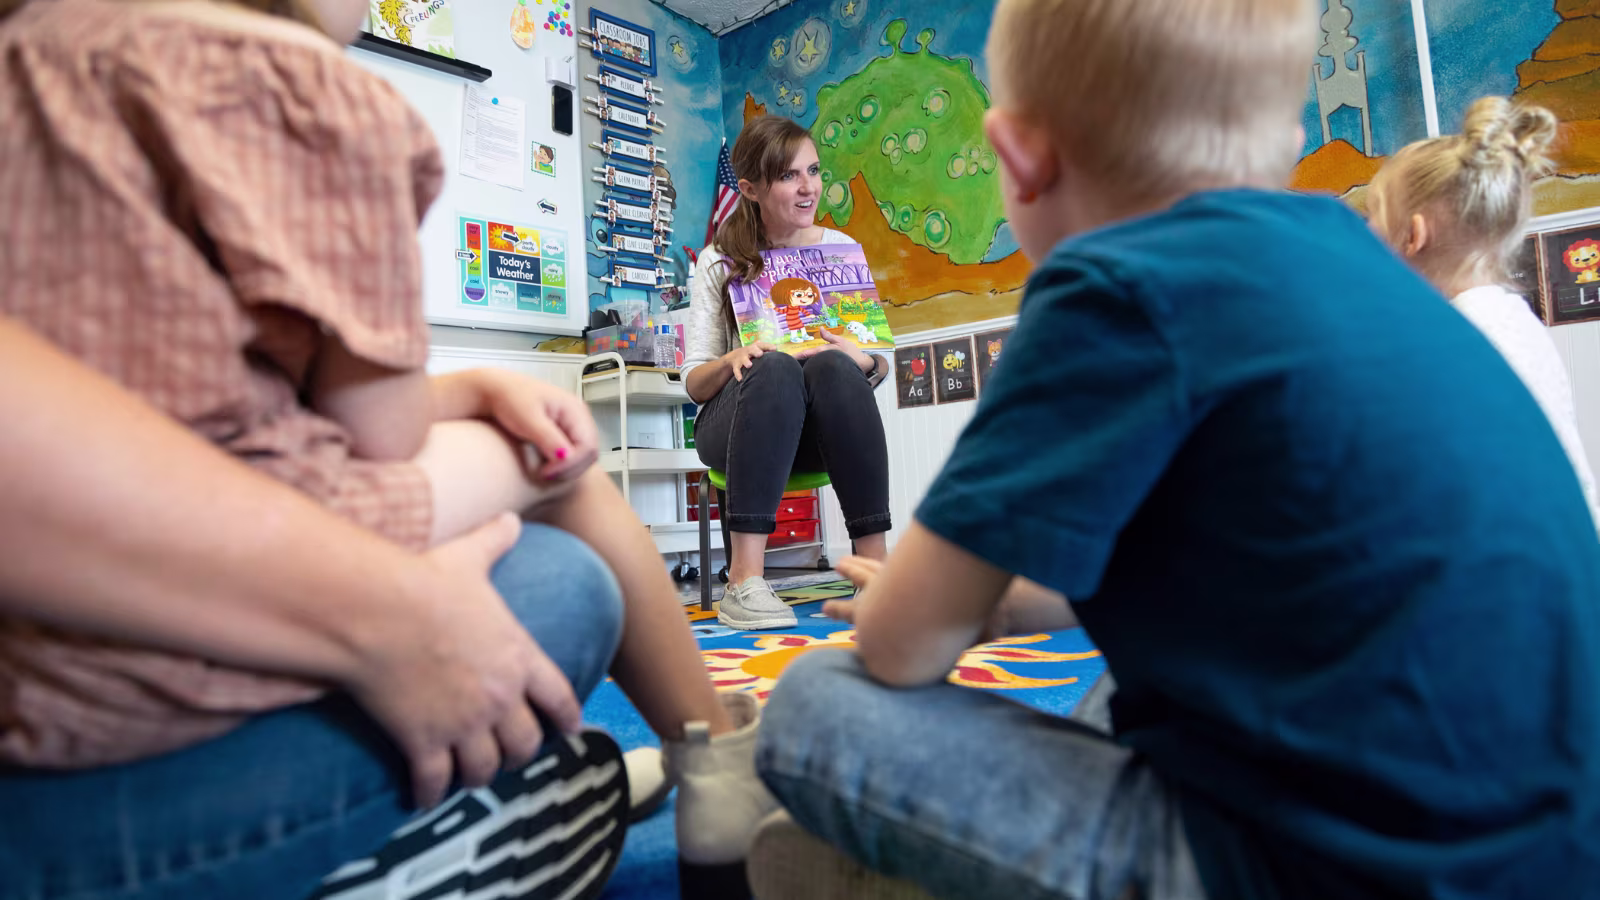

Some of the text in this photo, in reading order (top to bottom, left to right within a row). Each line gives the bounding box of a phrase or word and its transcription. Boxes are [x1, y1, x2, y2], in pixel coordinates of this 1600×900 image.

[600, 21, 646, 47] CLASSROOM JOBS
[620, 80, 635, 92] PLEDGE
[619, 111, 639, 124] CALENDAR
[626, 145, 644, 156] WEATHER
[498, 255, 531, 270] Today's
[776, 249, 802, 264] and
[496, 266, 534, 281] Weather
[631, 271, 649, 281] CABOOSE
[757, 266, 796, 286] opito
[947, 378, 963, 390] Bb
[909, 386, 923, 397] Aa
